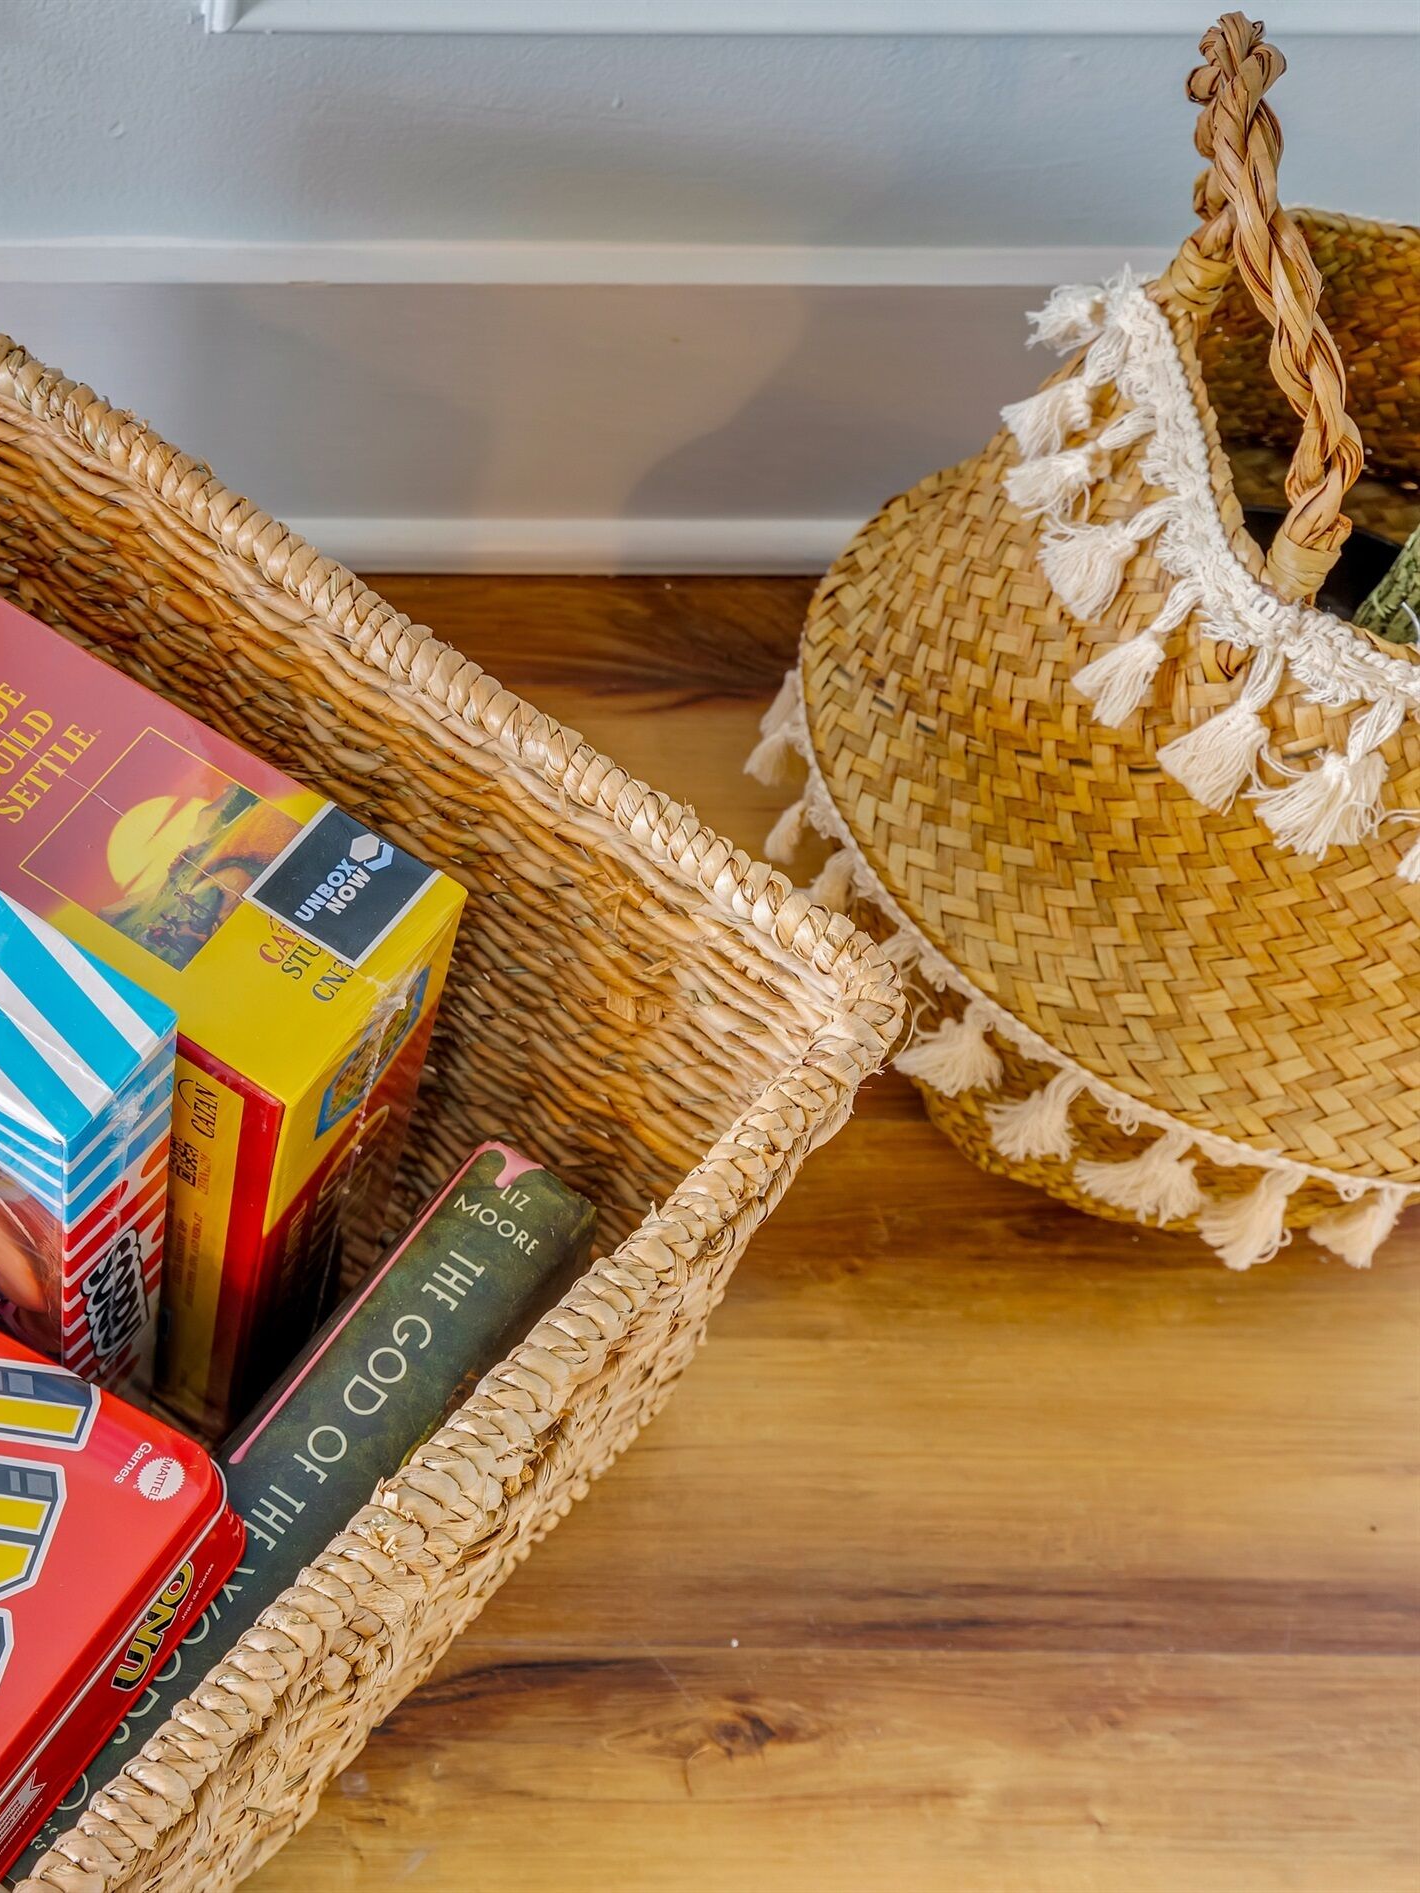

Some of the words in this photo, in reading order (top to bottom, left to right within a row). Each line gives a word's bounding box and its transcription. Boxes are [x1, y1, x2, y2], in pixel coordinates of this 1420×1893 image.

[294, 858, 358, 922] UNBOX
[325, 867, 371, 915] NOW
[191, 1081, 219, 1139] CATAN
[453, 1194, 540, 1256] MOORE
[499, 1185, 532, 1212] LIZ
[421, 1250, 485, 1311] THE
[343, 1314, 432, 1415] GOD
[114, 1442, 153, 1485] Games
[148, 1457, 174, 1500] MATTEL
[293, 1425, 348, 1484] OF
[244, 1485, 307, 1552] THE
[111, 1560, 194, 1692] UNO
